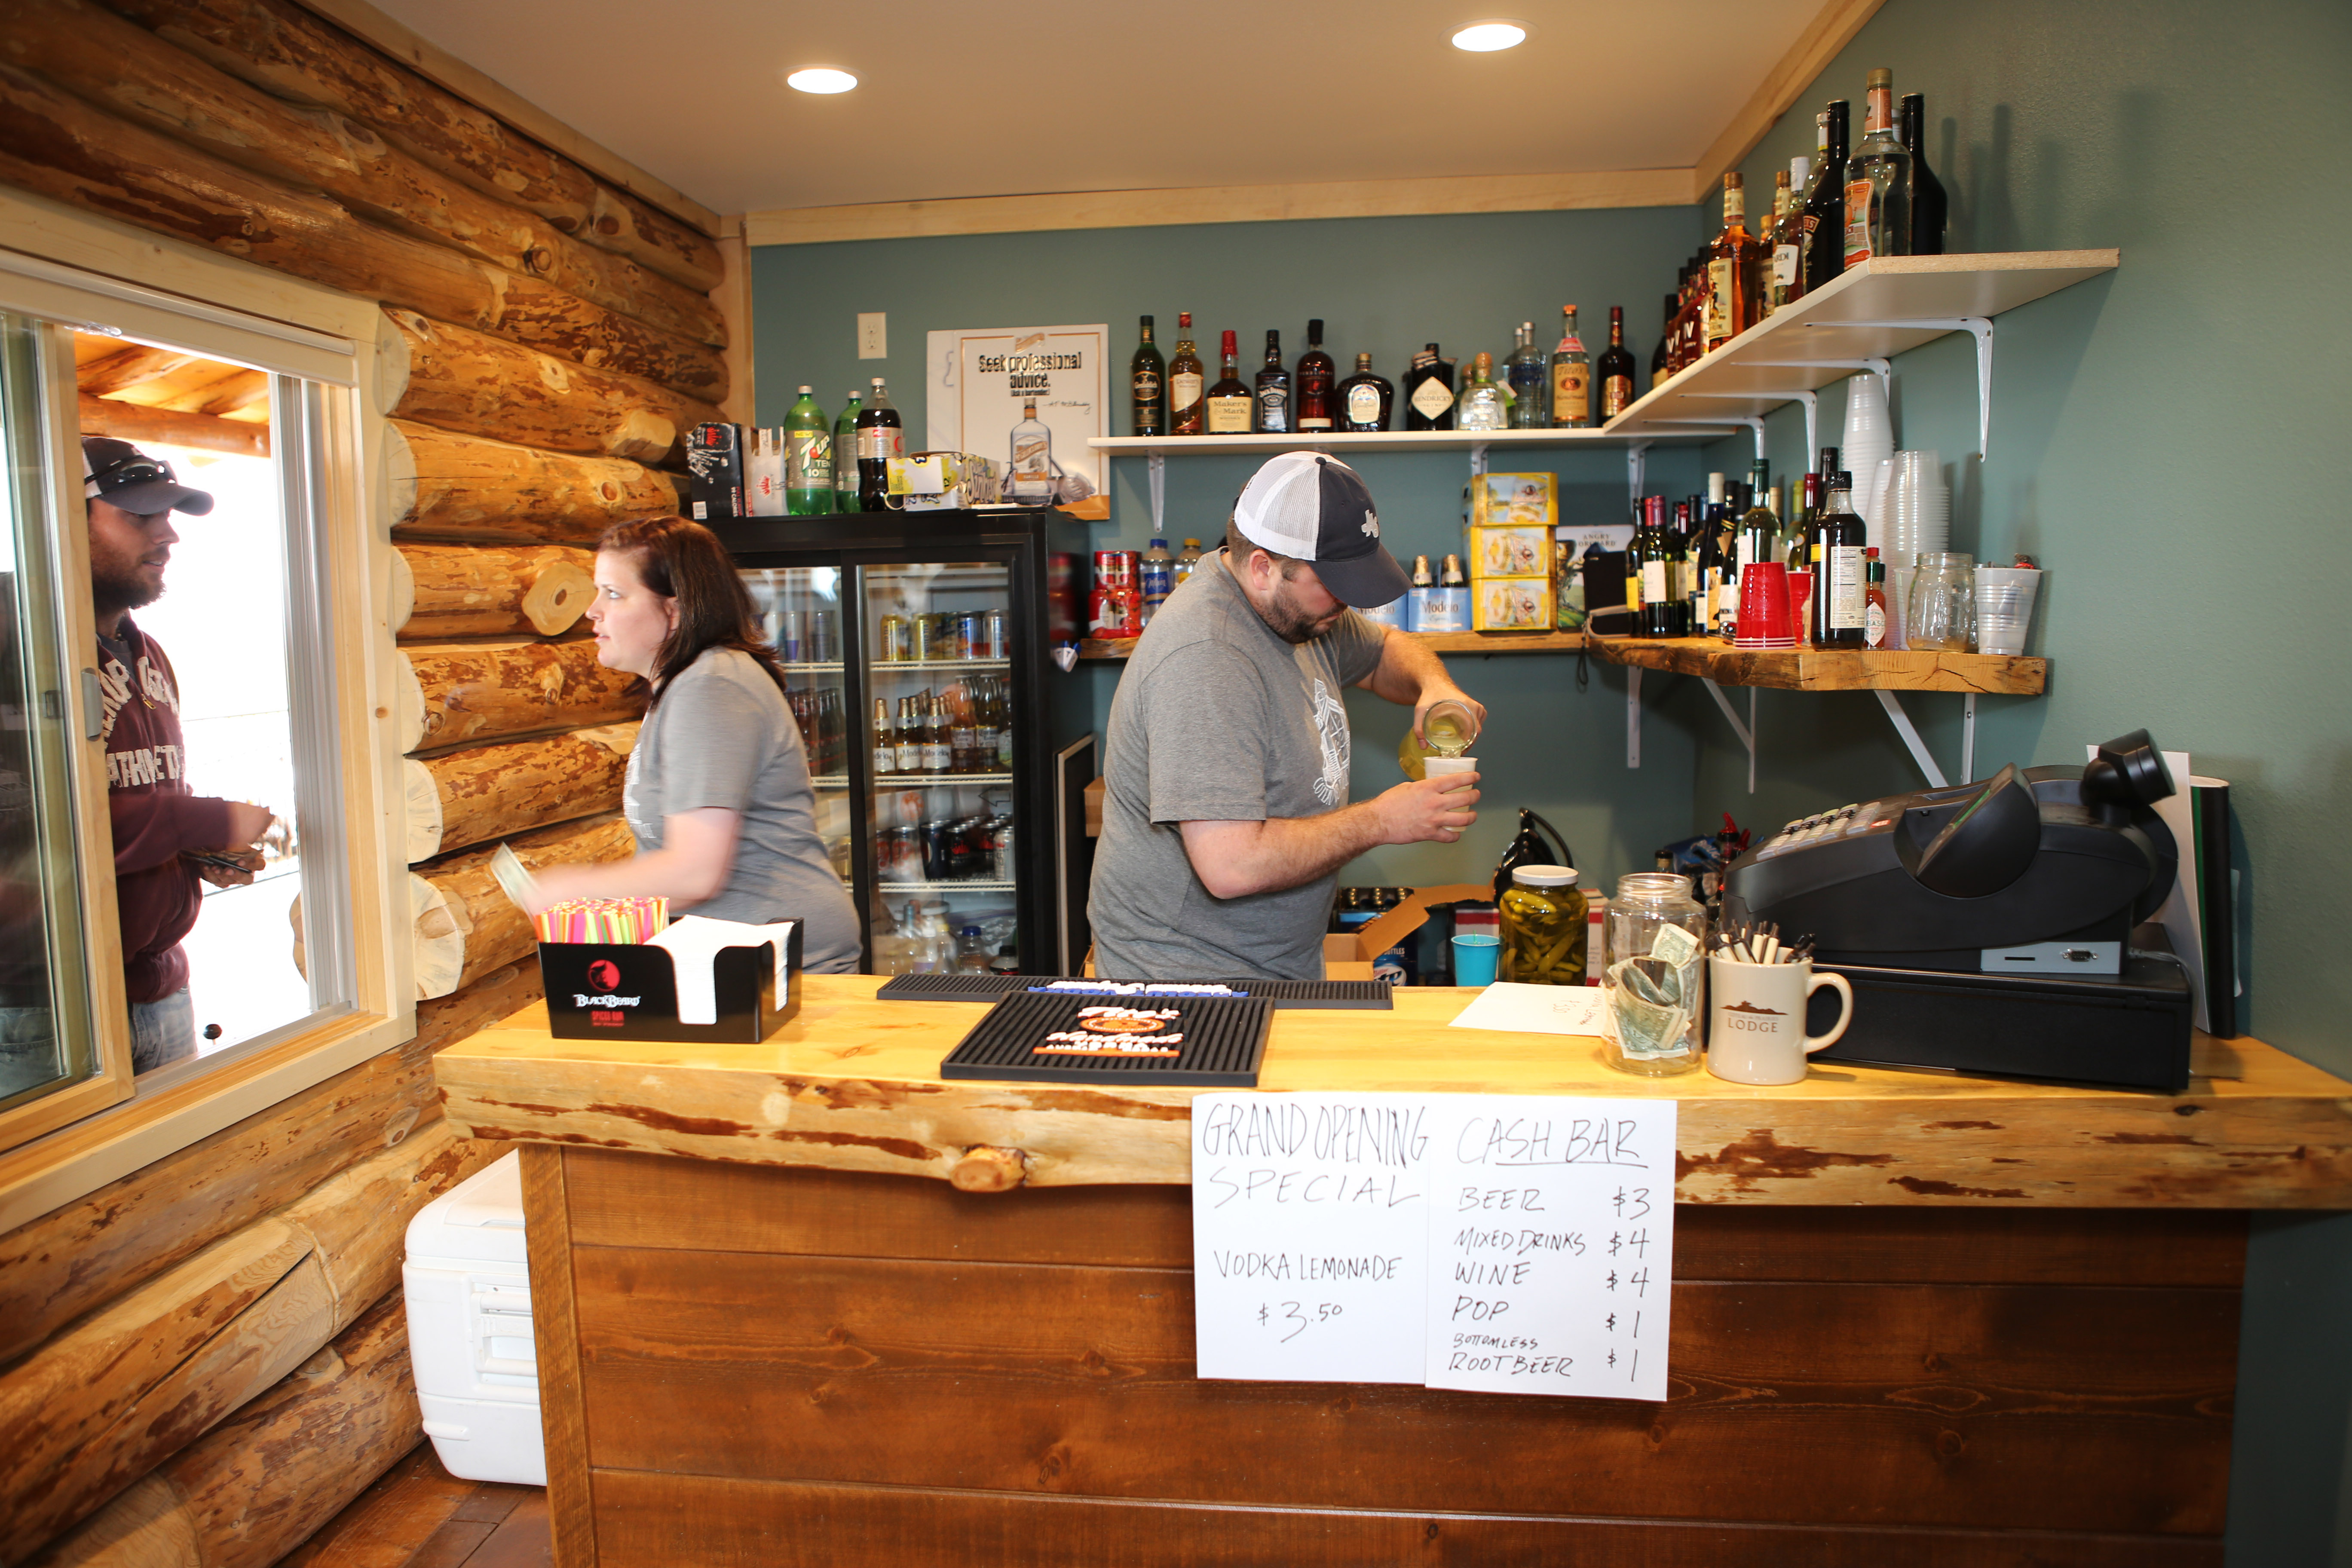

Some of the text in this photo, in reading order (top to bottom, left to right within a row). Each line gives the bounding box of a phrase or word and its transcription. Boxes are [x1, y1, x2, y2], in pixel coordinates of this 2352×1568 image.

[979, 351, 1081, 373] Seek professional
[1557, 364, 1584, 375] Tito's
[1010, 371, 1051, 389] advice.
[800, 435, 830, 470] 7UP
[1422, 601, 1458, 613] Modelo
[1728, 1017, 1778, 1032] LODGE
[1203, 1102, 1429, 1169] GRAND OPENING
[1458, 1117, 1640, 1164] CASH BAR
[1210, 1166, 1420, 1209] SPECIAL
[1458, 1186, 1545, 1212] BEER
[1454, 1227, 1514, 1250] MIXED
[1517, 1230, 1586, 1256] DRINKS
[1214, 1250, 1403, 1282] VODKA LEMONADE
[1455, 1261, 1531, 1286] WINE
[1452, 1294, 1510, 1321] POP
[1453, 1333, 1538, 1350] BOTTOMLESS
[1449, 1352, 1513, 1372] ROOT
[1512, 1355, 1573, 1377] BEER
